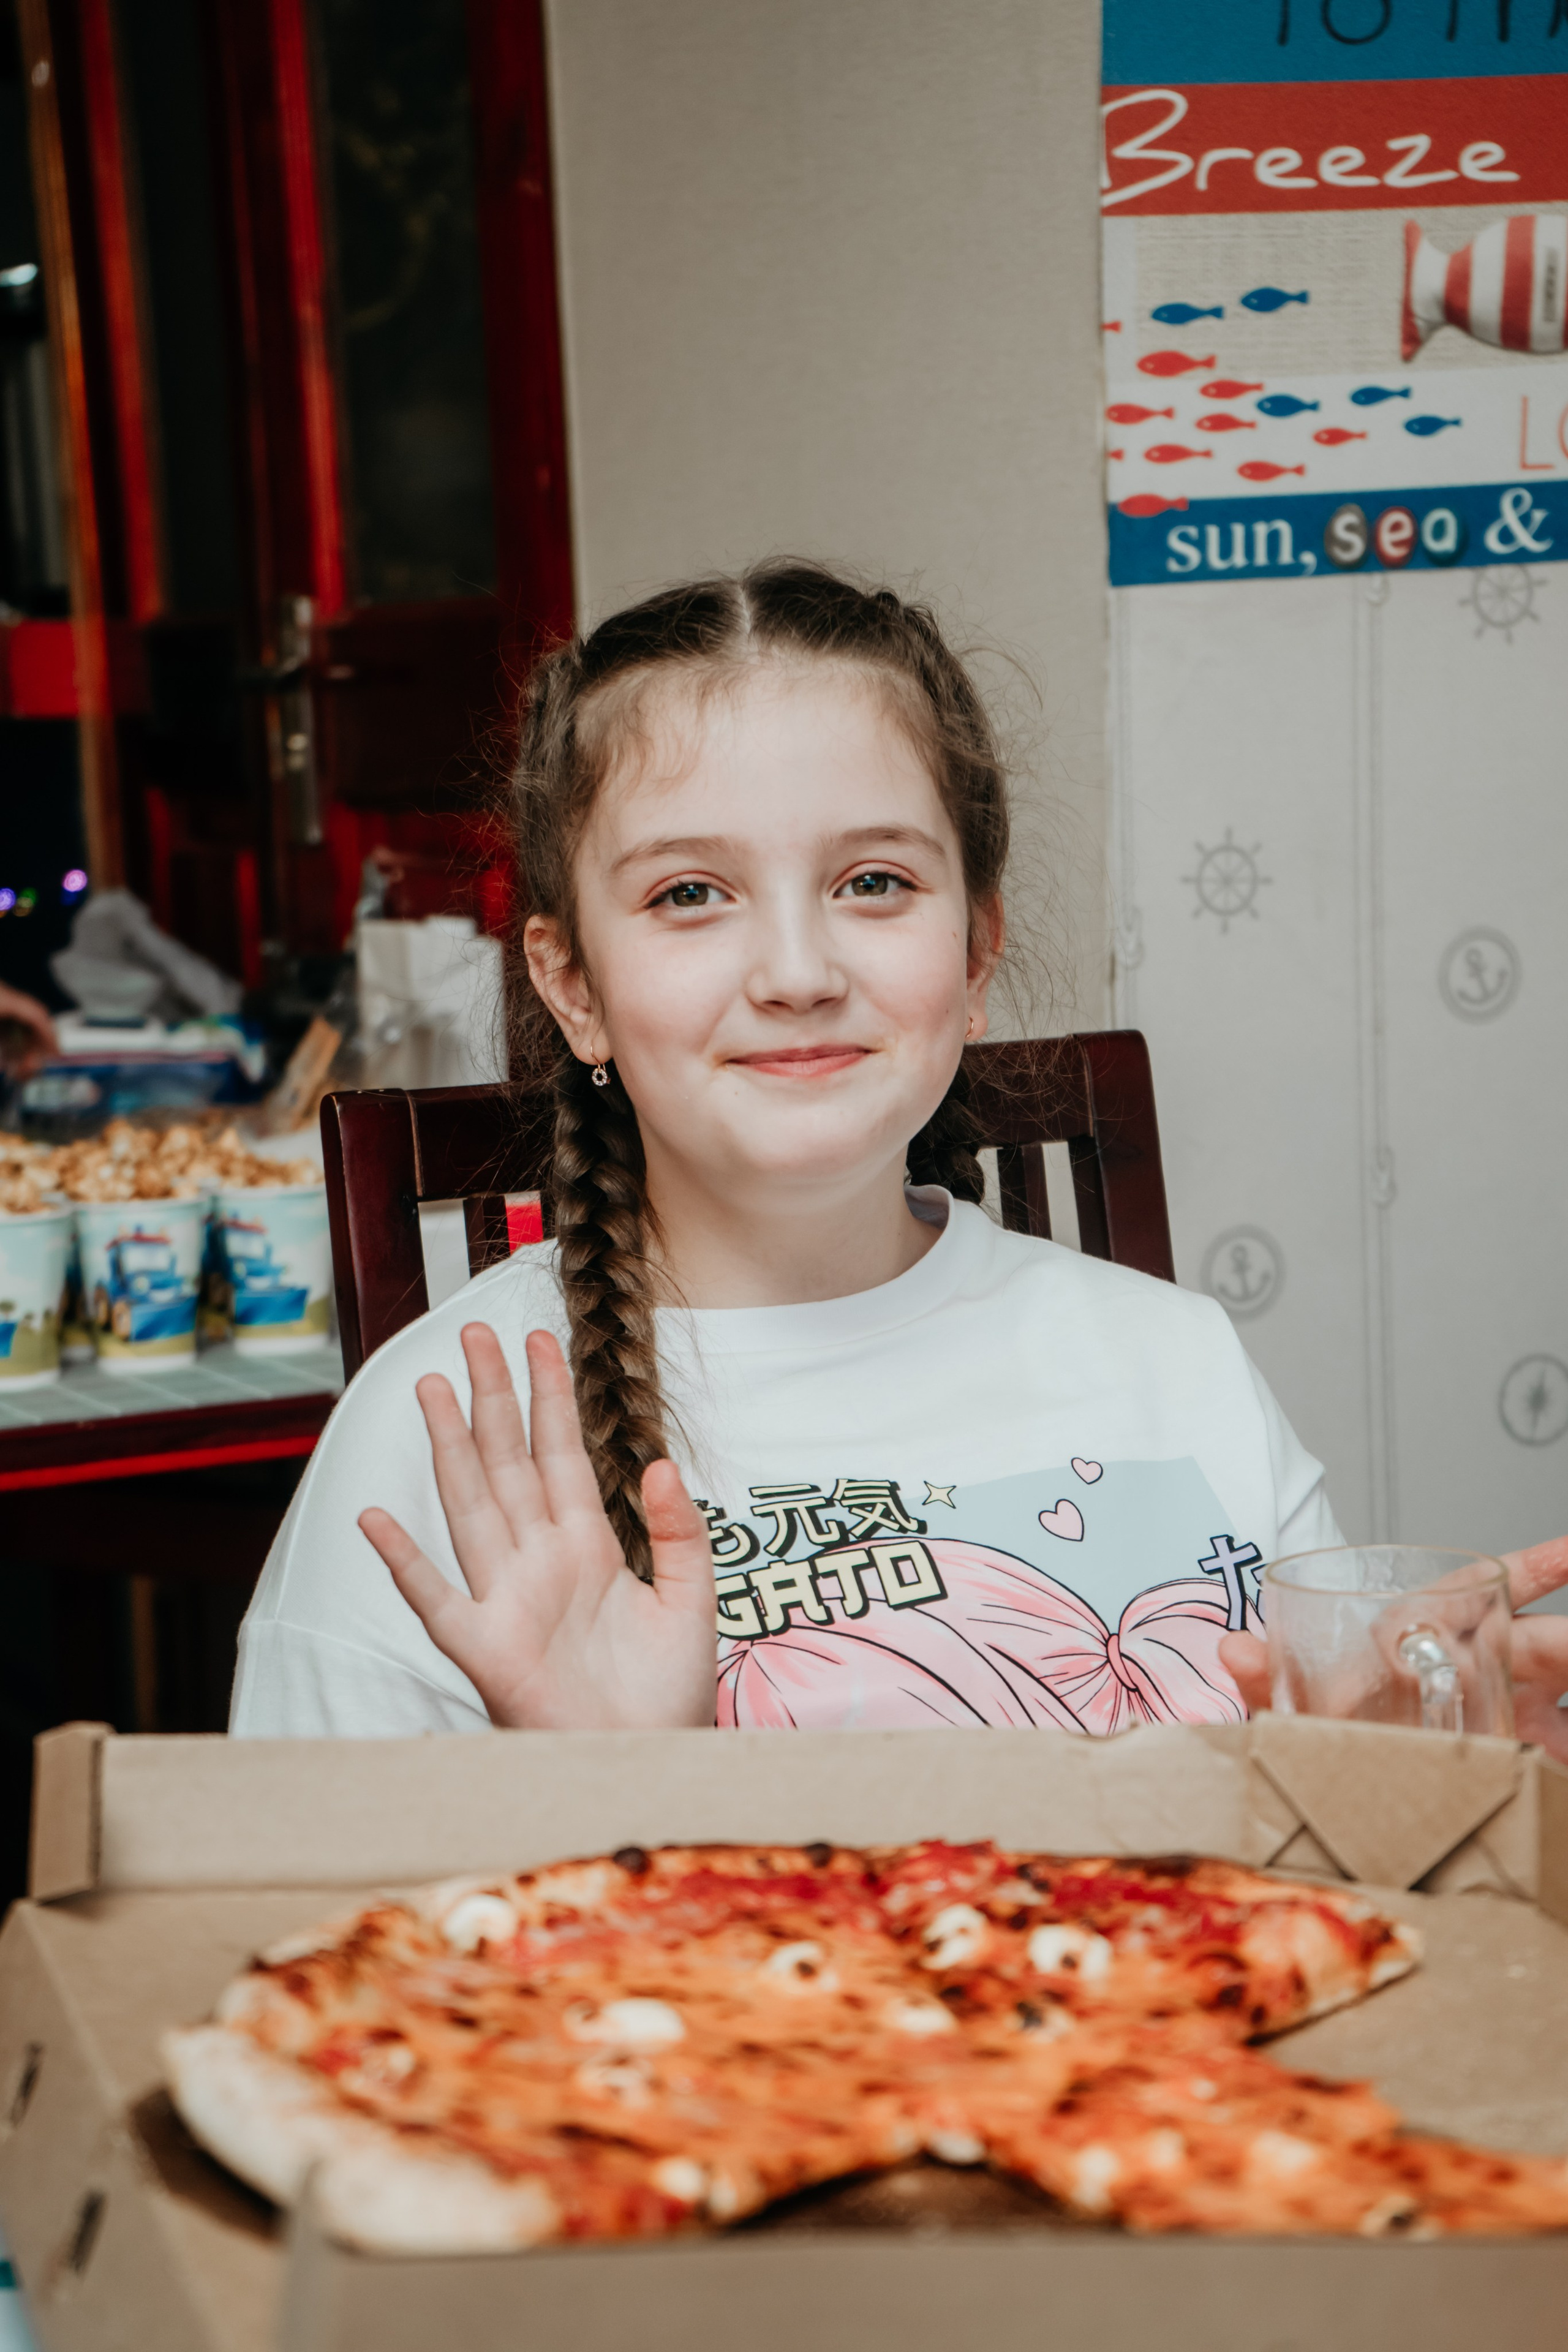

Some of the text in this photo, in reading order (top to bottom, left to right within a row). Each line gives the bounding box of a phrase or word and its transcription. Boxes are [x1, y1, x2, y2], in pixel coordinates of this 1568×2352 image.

[1100, 88, 1521, 208] Breeze
[1520, 394, 1568, 470] L
[1166, 487, 1555, 577] sun, sea &
